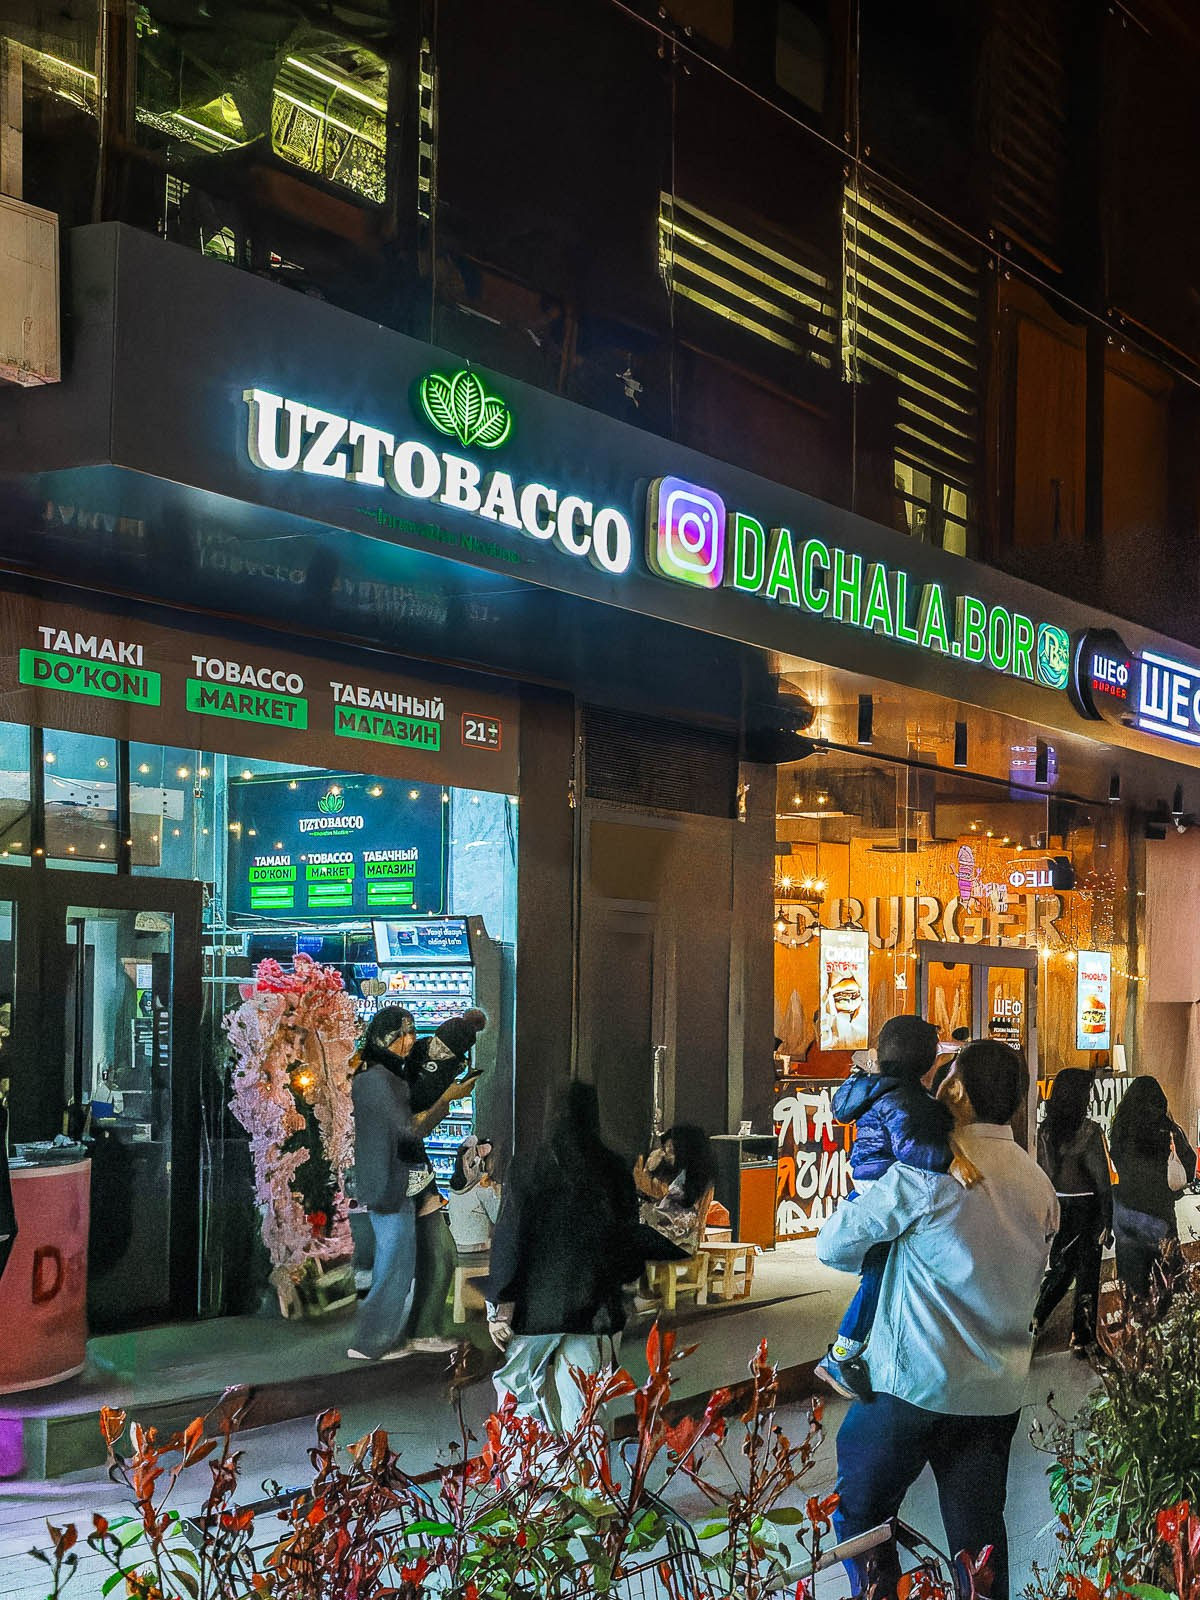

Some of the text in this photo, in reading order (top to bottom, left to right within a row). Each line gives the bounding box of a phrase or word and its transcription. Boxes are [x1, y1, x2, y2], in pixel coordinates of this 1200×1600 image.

[245, 389, 632, 574] UZTOBACCO
[730, 511, 1035, 681] DACHALA.BOR
[38, 625, 144, 666] TAMAKI
[33, 657, 149, 698] DO'KONI
[191, 655, 305, 695] TOBACCO
[1093, 654, 1129, 686] ШЕФ
[200, 687, 298, 722] MARKET
[330, 681, 445, 721] ТАБАЧНЫЙ
[1093, 679, 1127, 699] BURGER
[338, 708, 438, 745] МАГАЗИН
[298, 815, 364, 833] UZTOBACCO
[254, 856, 291, 866] TAMAKI
[308, 852, 353, 864] TOBACCO
[363, 847, 418, 861] ТАБАЧНЫЙ
[367, 865, 414, 875] МАГАЗИН
[311, 866, 350, 877] MARKET
[994, 999, 1021, 1016] ШЕФ
